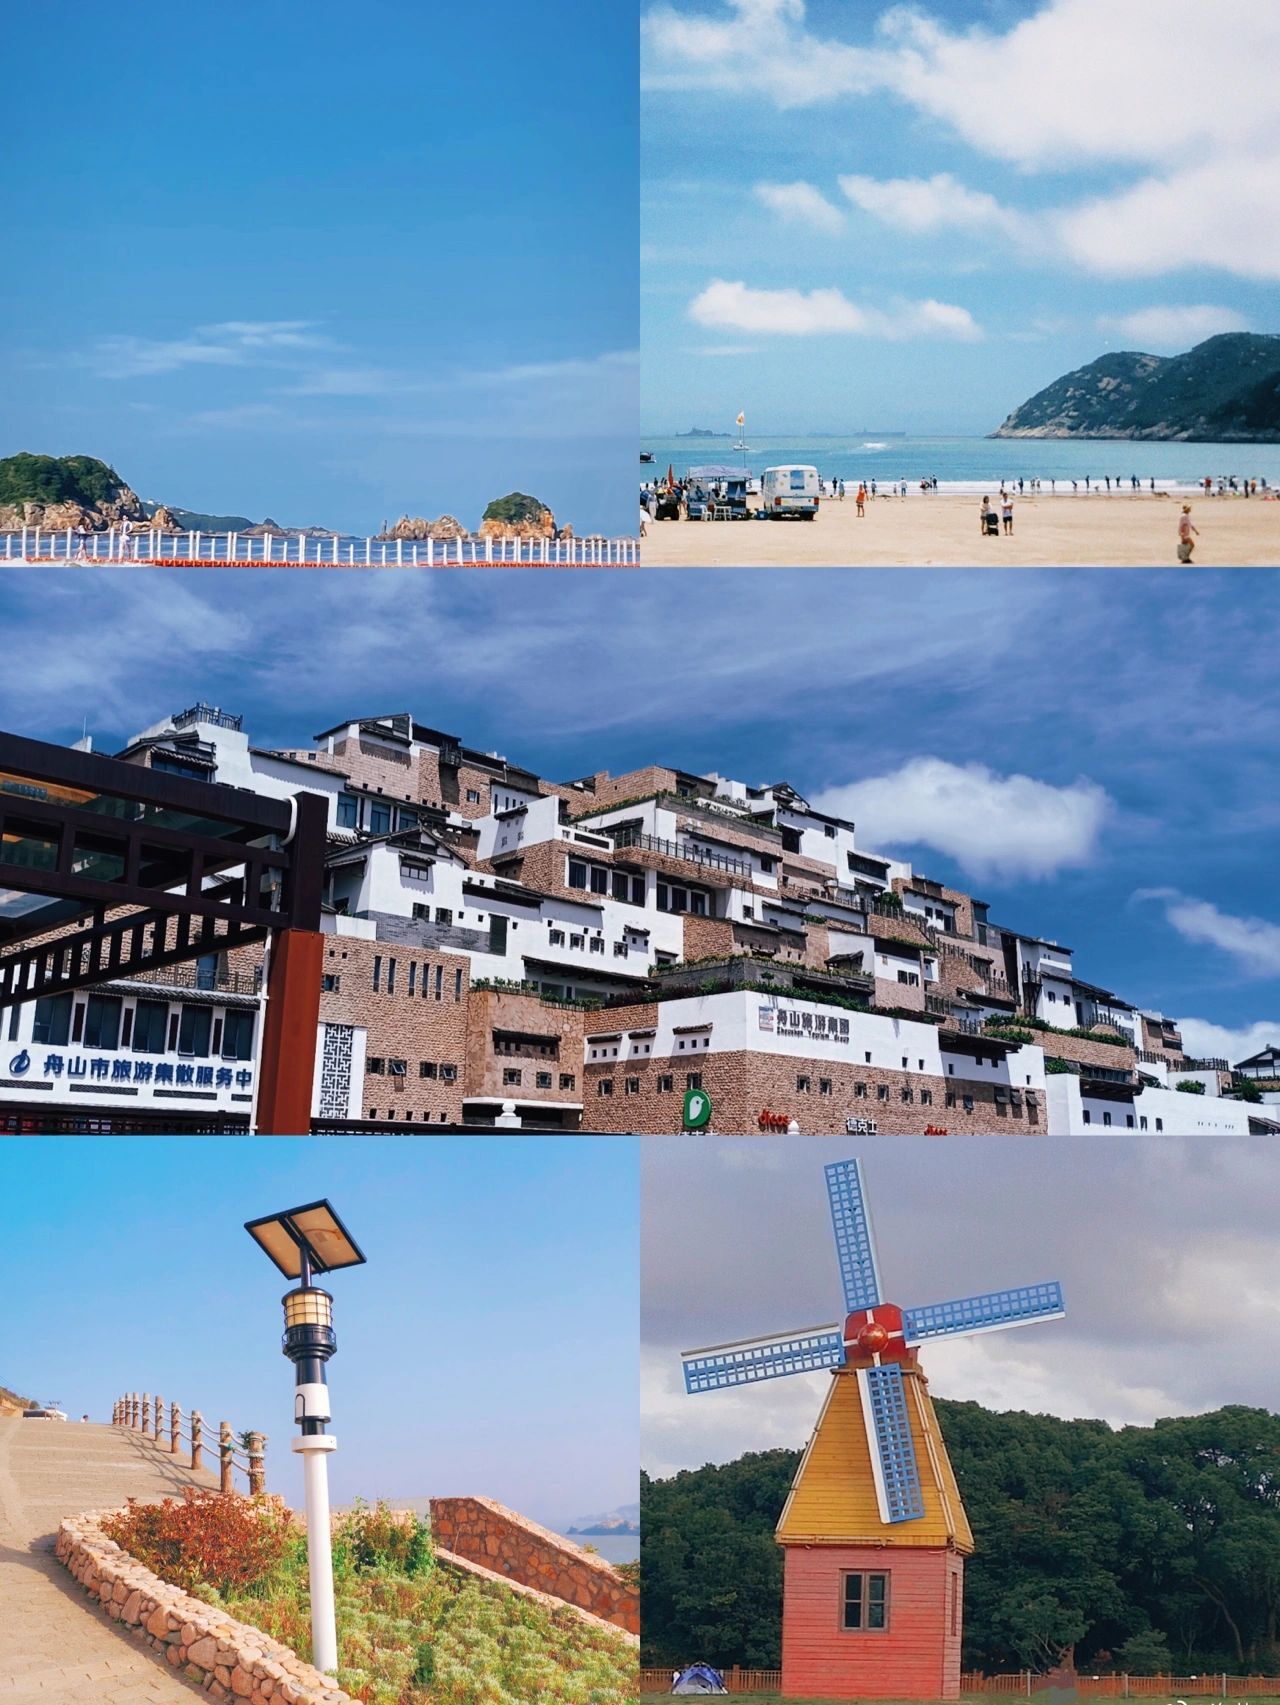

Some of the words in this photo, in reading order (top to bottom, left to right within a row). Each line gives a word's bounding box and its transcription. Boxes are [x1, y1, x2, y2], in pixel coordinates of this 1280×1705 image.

[44, 1054, 252, 1090] 舟山市旅游集散服务中
[847, 1117, 877, 1133] 德克士
